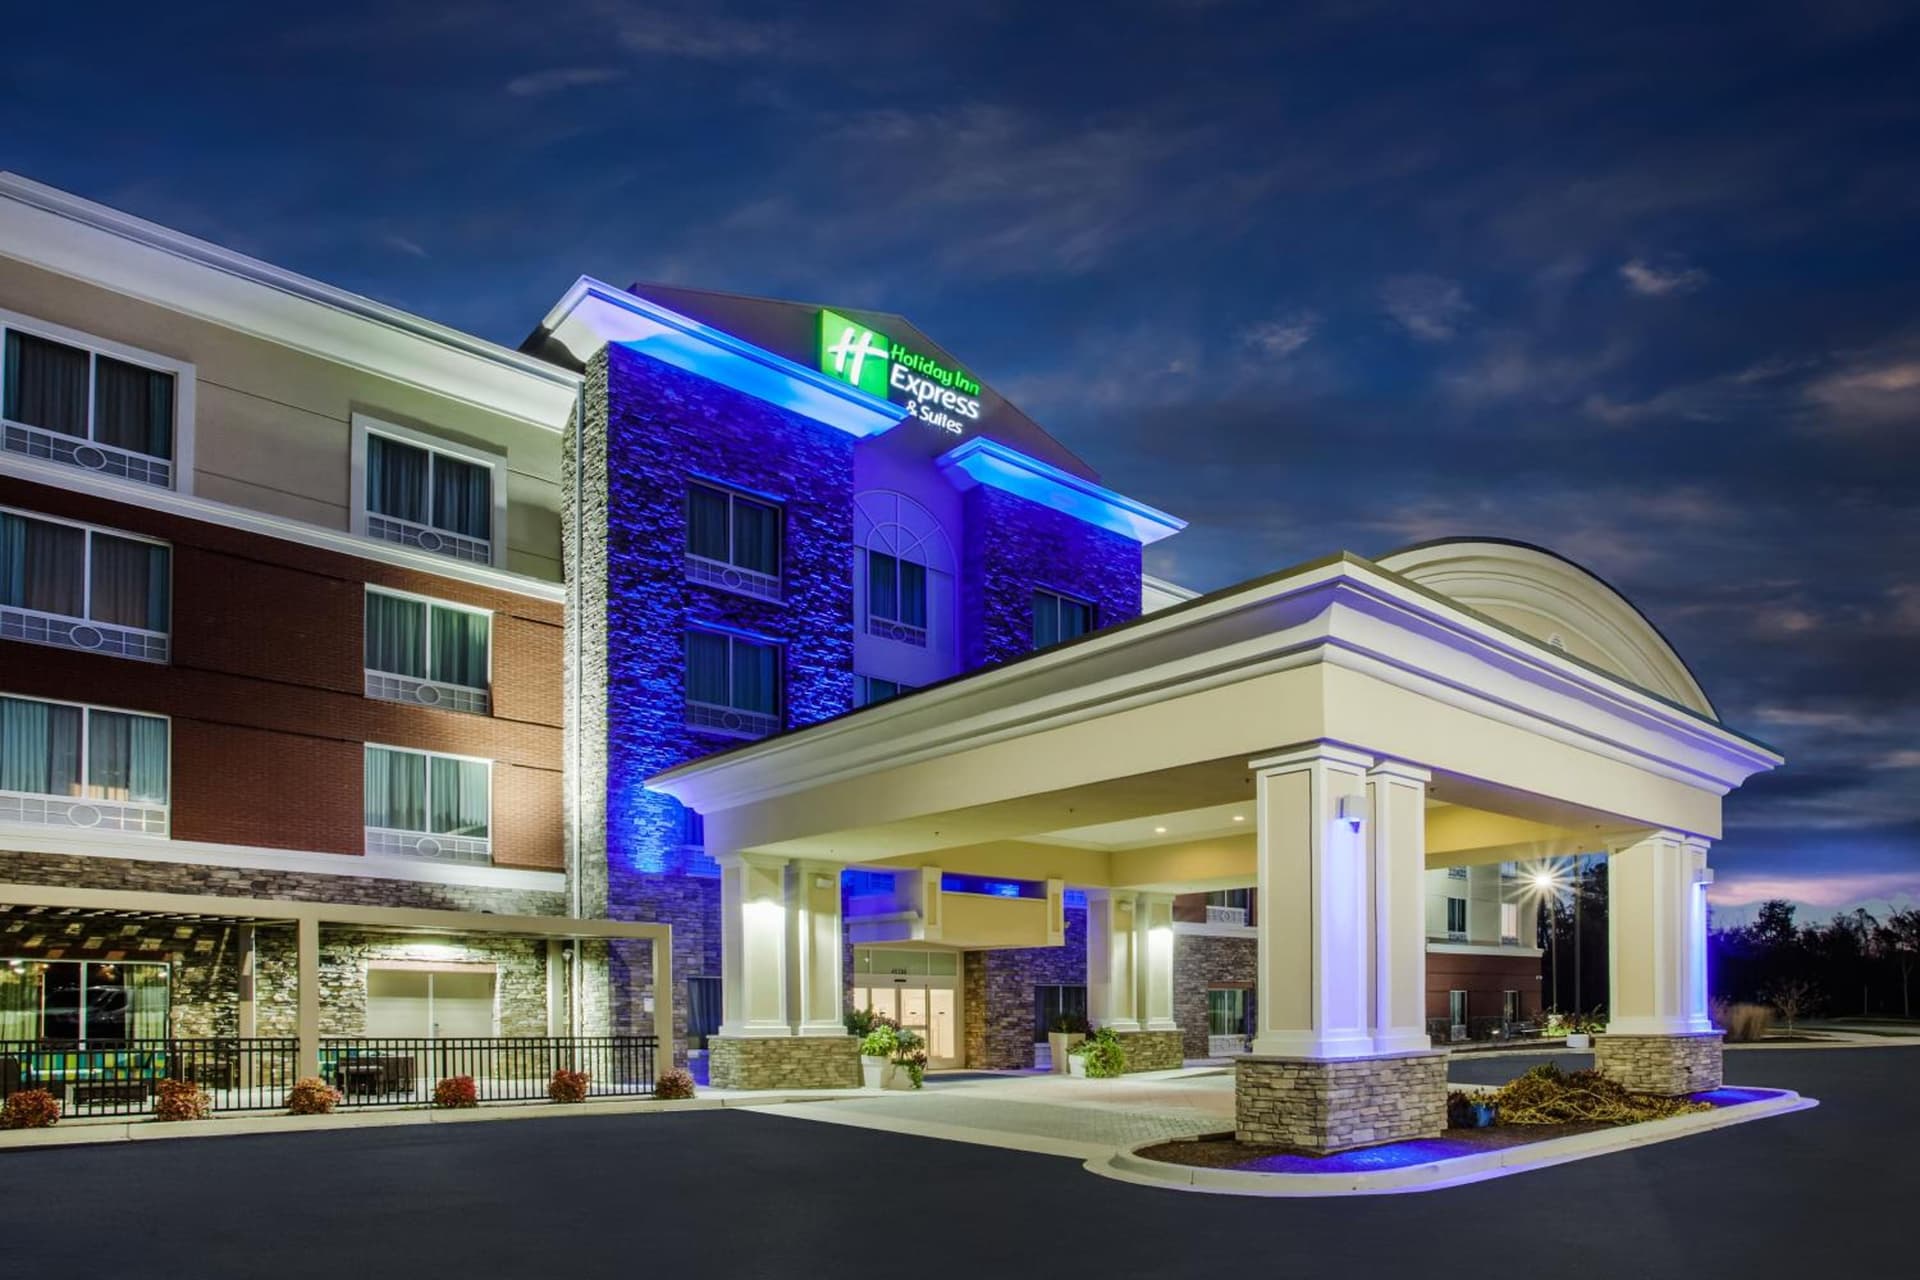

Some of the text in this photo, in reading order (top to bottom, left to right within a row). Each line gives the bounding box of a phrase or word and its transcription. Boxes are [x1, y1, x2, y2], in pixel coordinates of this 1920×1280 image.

[890, 363, 980, 419] Express
[891, 344, 980, 396] Holiday Inn
[906, 400, 963, 434] & Suites
